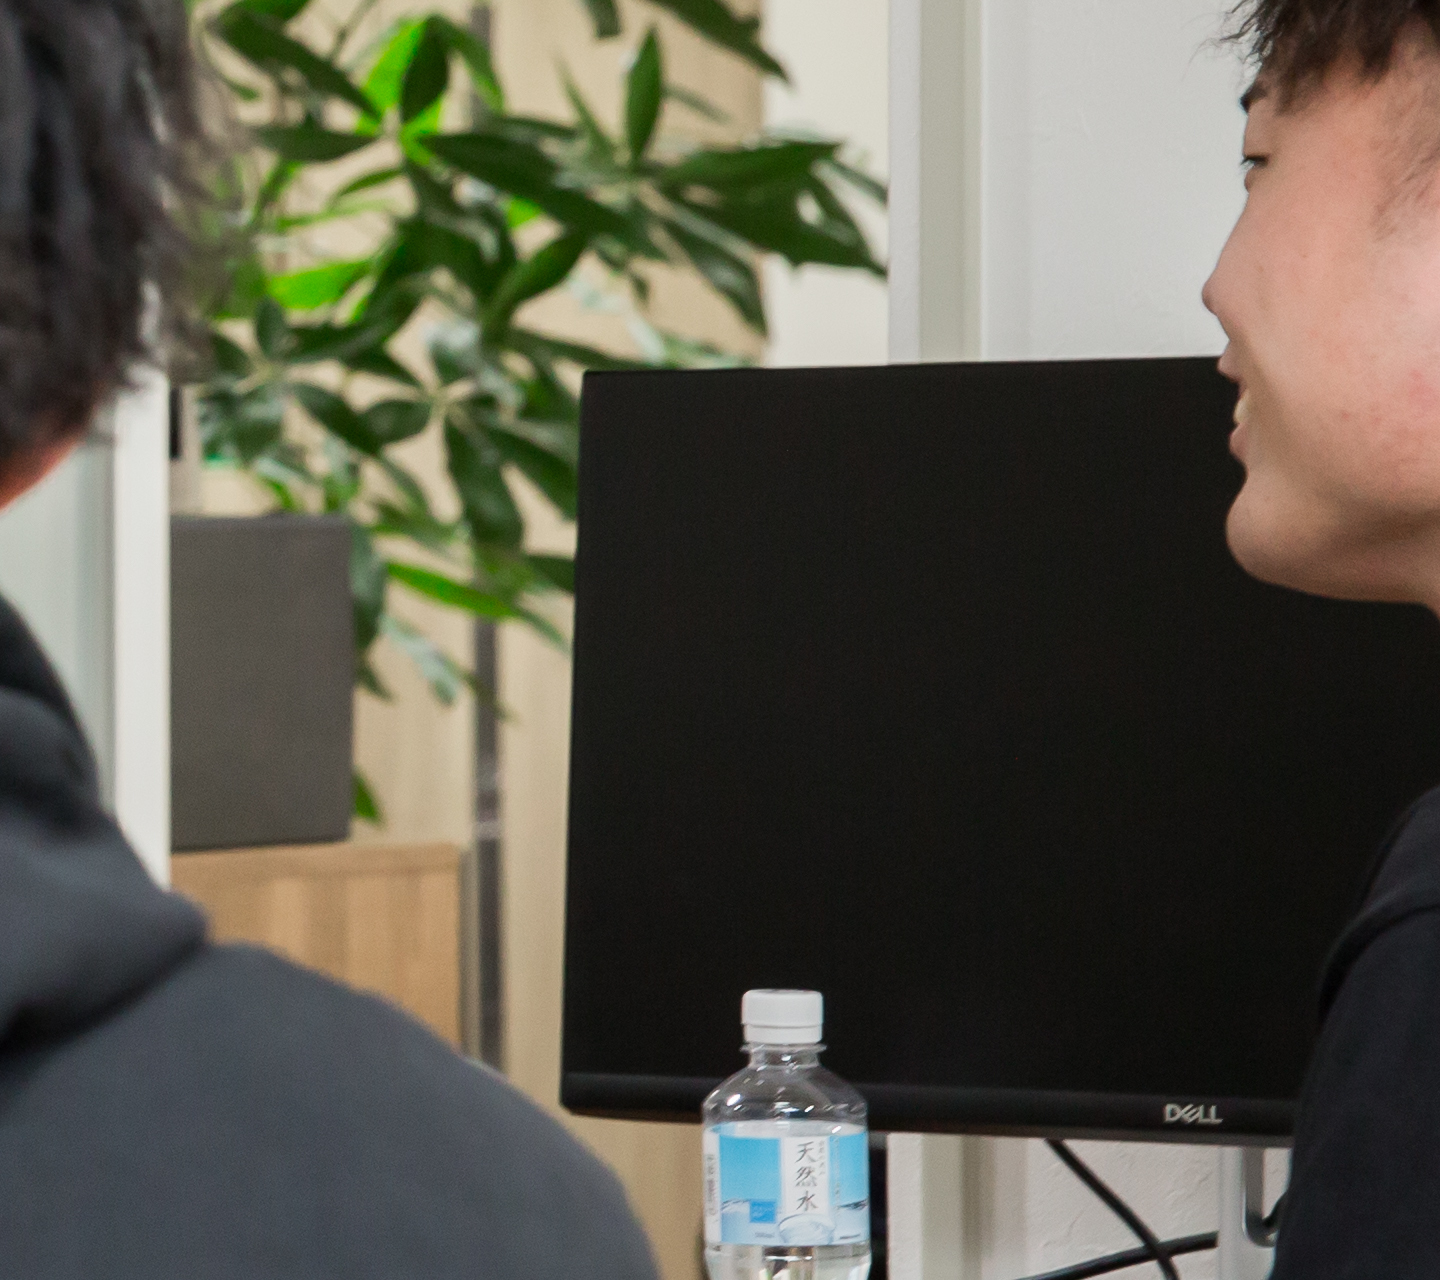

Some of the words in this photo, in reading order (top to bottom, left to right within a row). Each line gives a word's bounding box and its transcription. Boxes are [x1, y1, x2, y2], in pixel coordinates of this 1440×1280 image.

[1164, 1103, 1223, 1124] DELL
[794, 1140, 820, 1212] 天然水
